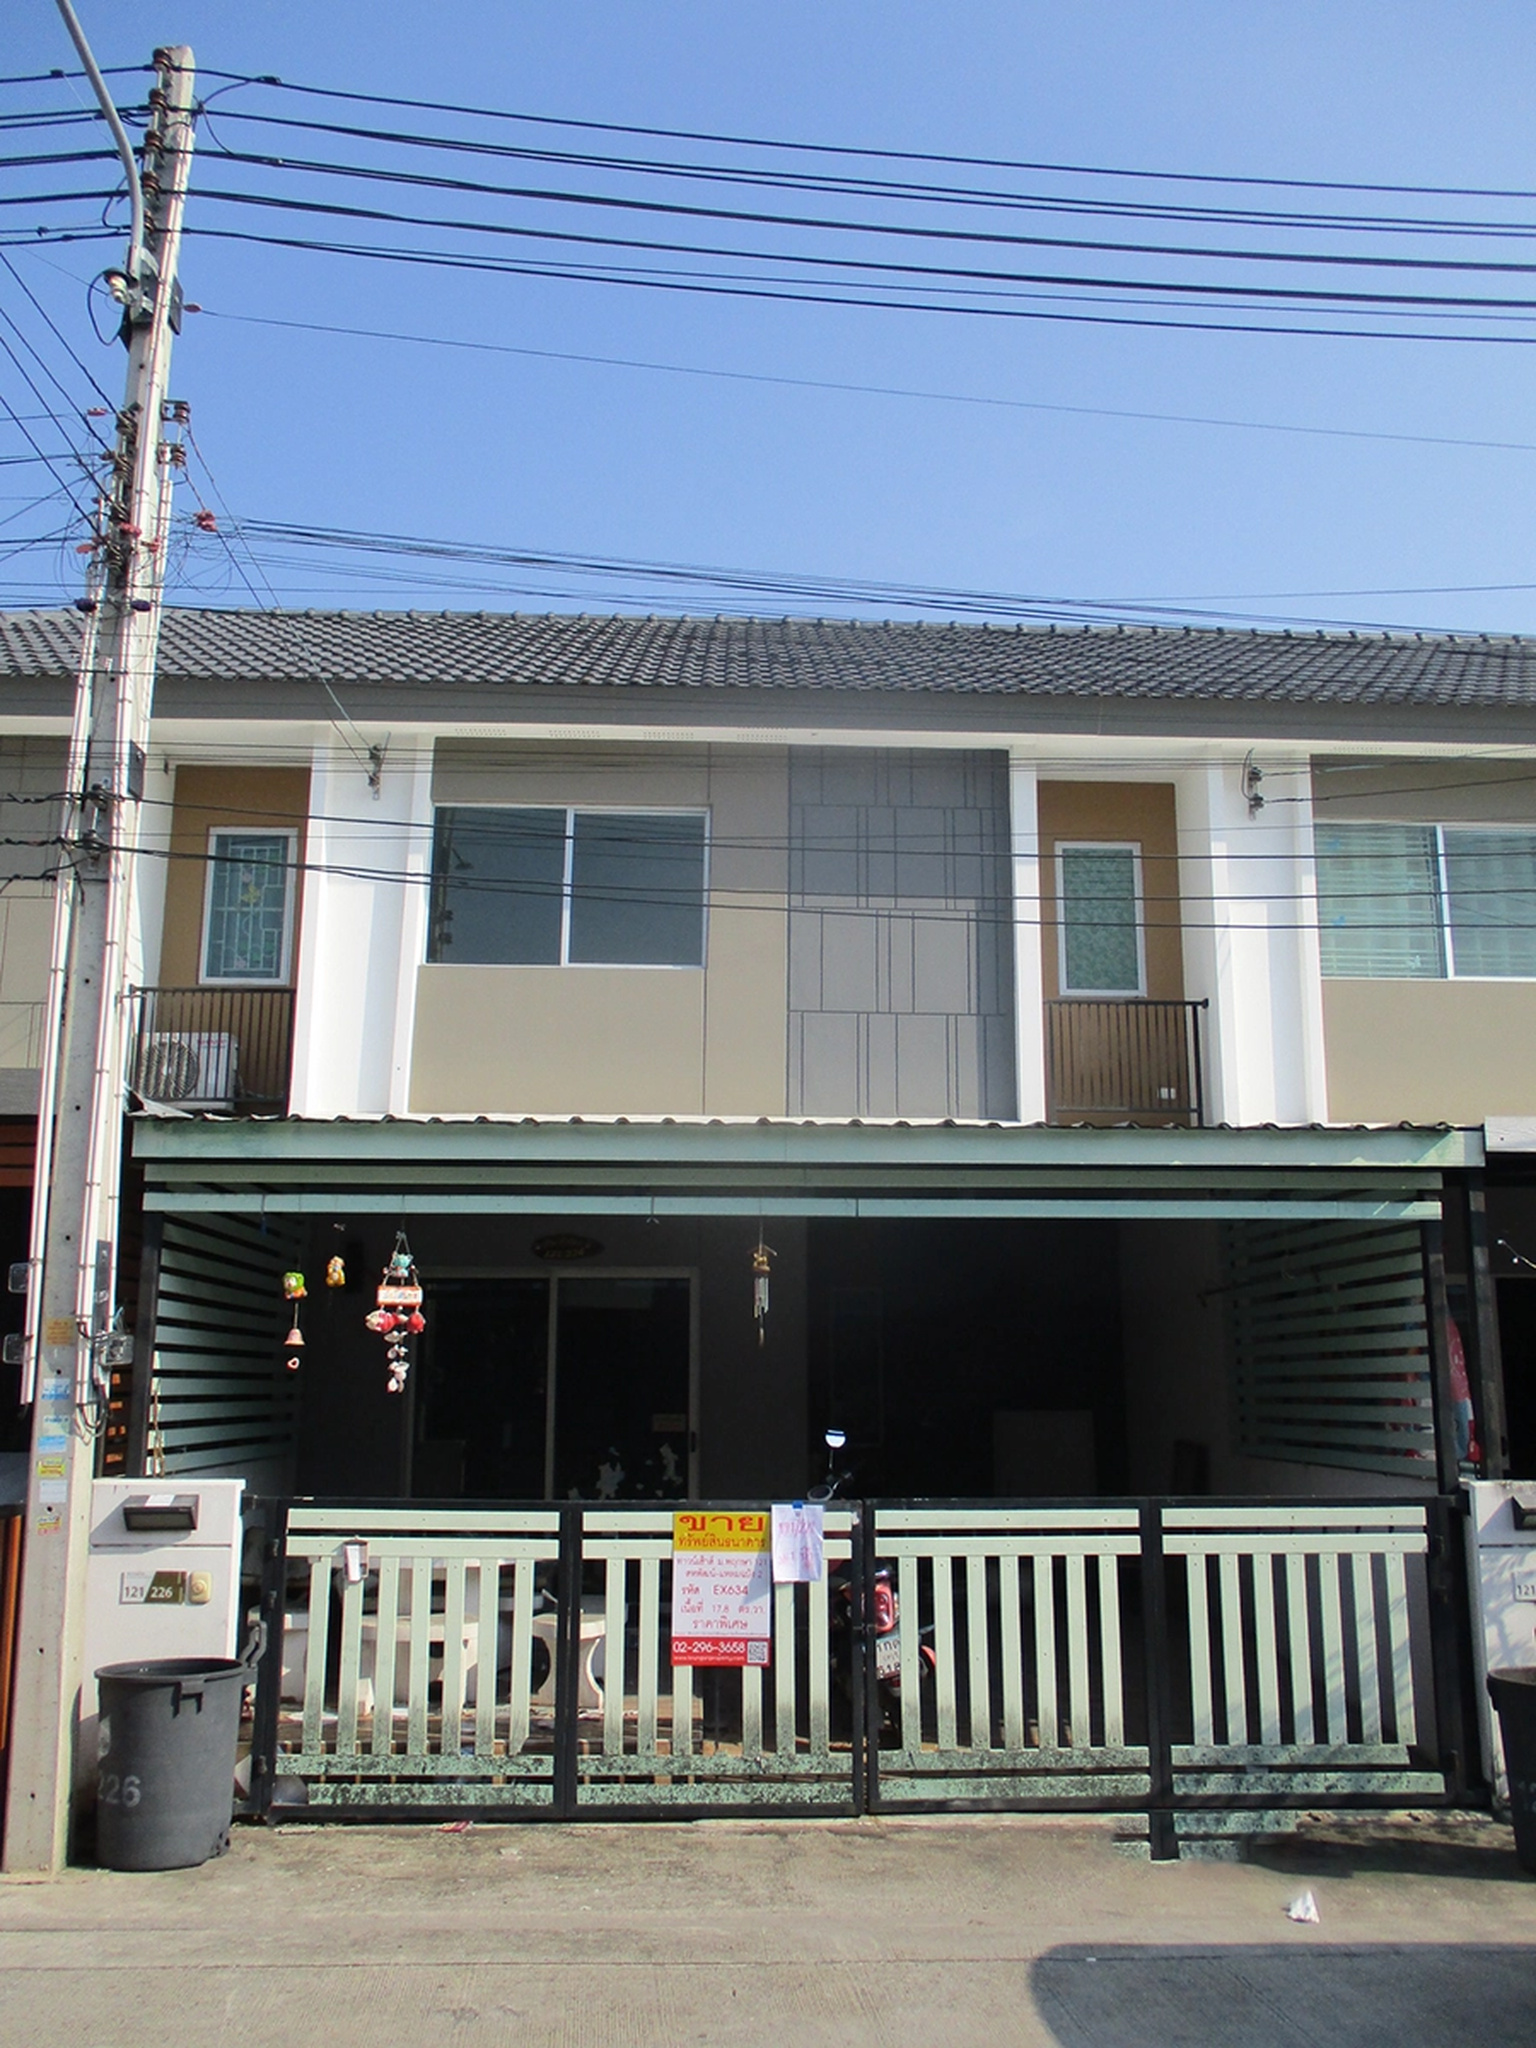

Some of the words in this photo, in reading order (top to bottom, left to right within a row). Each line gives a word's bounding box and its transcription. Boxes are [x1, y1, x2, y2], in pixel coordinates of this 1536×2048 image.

[679, 1515, 764, 1532] ขาย
[125, 1586, 144, 1598] 121
[150, 1586, 174, 1599] 226
[713, 1584, 748, 1595] EX634
[673, 1641, 746, 1653] 02-296-3658
